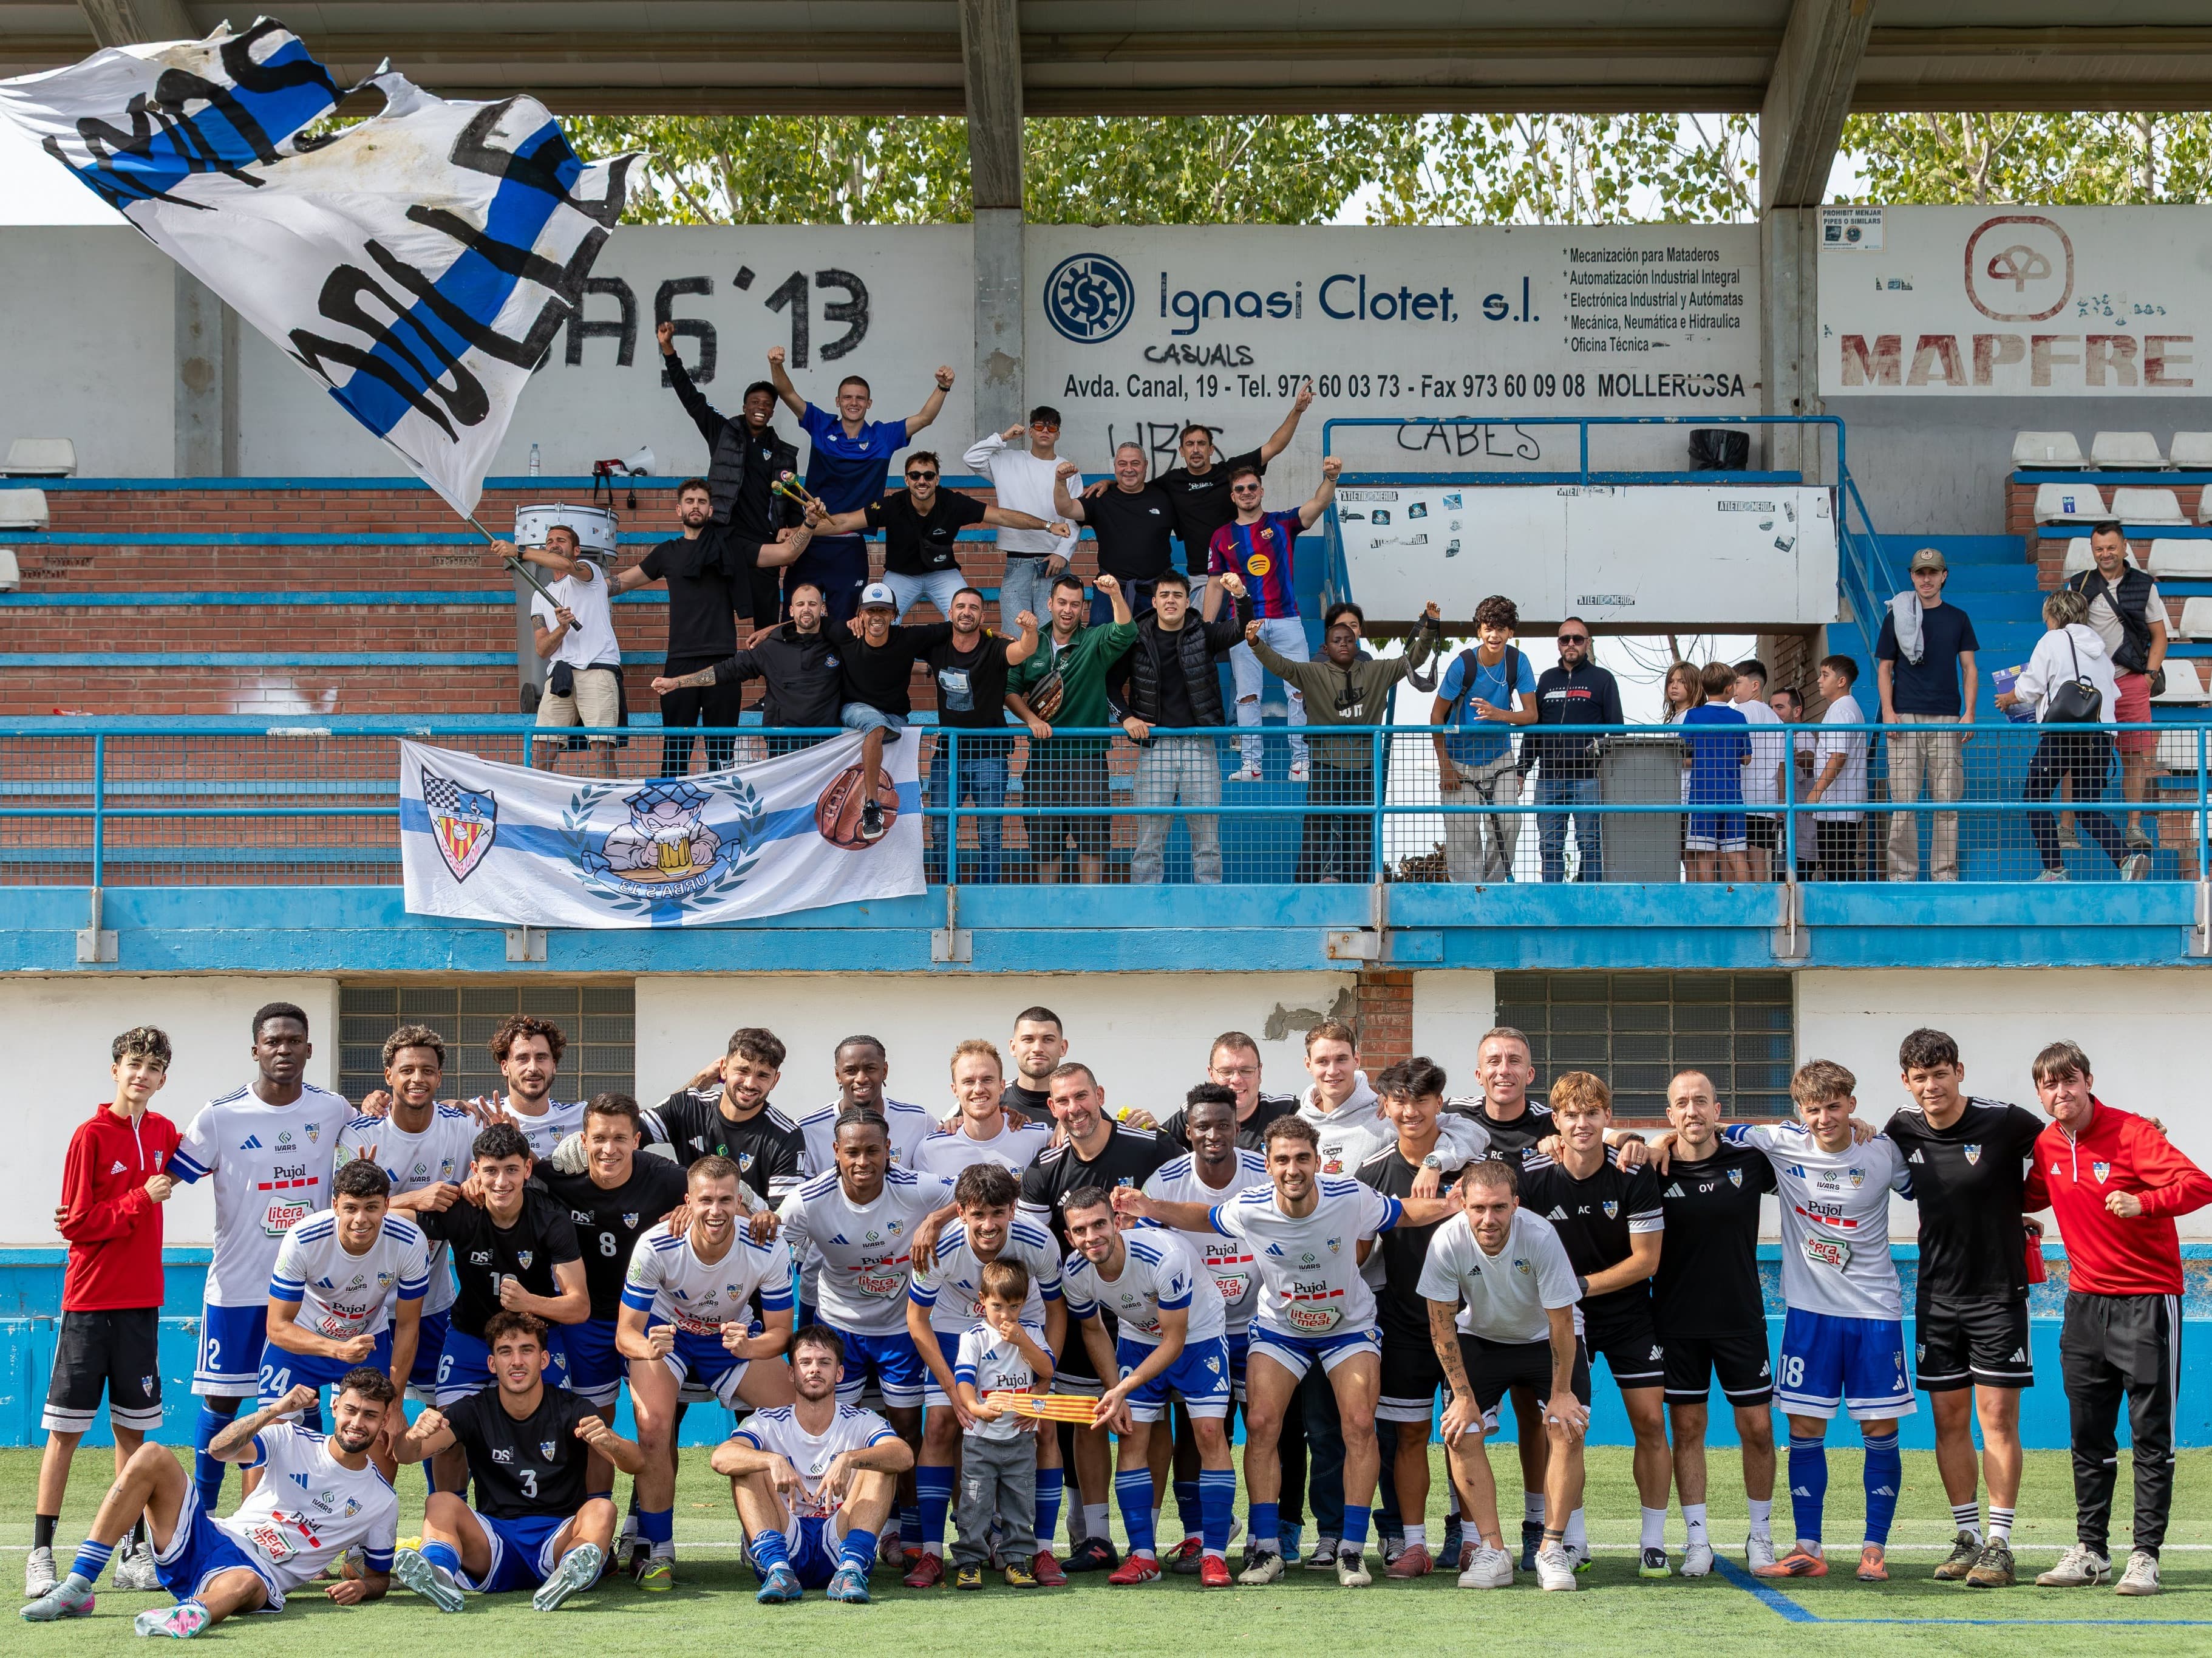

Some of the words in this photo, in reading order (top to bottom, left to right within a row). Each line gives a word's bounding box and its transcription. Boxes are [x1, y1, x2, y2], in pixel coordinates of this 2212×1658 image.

[1570, 247, 1638, 262] Mecanización
[1642, 250, 1663, 265] para
[1667, 247, 1719, 262] Mataderos
[1570, 269, 1649, 285] Automatización
[1652, 269, 1698, 284] Industrial
[1701, 268, 1740, 287] Integral
[1160, 271, 1302, 335] Ignasi
[1319, 274, 1458, 322] Clotet,
[1483, 276, 1540, 322] s.l.
[1571, 292, 1627, 307] Electrónica
[1630, 292, 1677, 307] Industrial
[1680, 295, 1686, 310] y
[1689, 291, 1743, 306] Autómatas
[1571, 315, 1621, 332] Mecánica,
[1624, 313, 1677, 329] Neumática
[1680, 318, 1686, 329] e
[1689, 313, 1740, 329] Hidraulica
[1571, 337, 1606, 352] Oficina
[1610, 336, 1649, 352] Técnica
[1144, 344, 1254, 367] CASUALS
[1841, 335, 2193, 386] MAPFRE
[1064, 374, 1119, 398] Avda.
[1126, 374, 1188, 401] Canal,
[1196, 374, 1217, 397] 19
[1237, 374, 1271, 397] Tel.
[1319, 374, 1341, 397] 60
[1349, 374, 1370, 397] 03
[1377, 374, 1400, 397] 73
[1421, 374, 1456, 398] Fax
[1463, 374, 1497, 397] 973
[1504, 374, 1526, 397] 60
[1533, 374, 1556, 397] 09
[1562, 374, 1585, 397] 08
[1598, 374, 1746, 397] MOLLERUSSA
[1354, 704, 1363, 717] IT
[1491, 1150, 1503, 1160] RC
[111, 1166, 128, 1175] adidas
[273, 1164, 306, 1179] Pujol
[1699, 1182, 1714, 1193] OV
[1817, 1181, 1840, 1190] IVARS
[268, 1207, 303, 1222] litera
[1578, 1206, 1590, 1214] AC
[1808, 1200, 1842, 1217] Pujol
[599, 1232, 616, 1257] 8
[1205, 1243, 1239, 1258] Pujol
[860, 1252, 894, 1265] Pujl
[346, 1283, 367, 1292] IVARS
[858, 1275, 893, 1286] litera
[867, 1280, 899, 1292] meat
[1293, 1280, 1327, 1294] Pujol
[1221, 1284, 1242, 1298] eat
[332, 1301, 367, 1314] Pujol
[1121, 1301, 1142, 1310] IVARS
[688, 1312, 722, 1323] Pujol
[1290, 1309, 1327, 1320] litera
[322, 1317, 358, 1333] litera
[1298, 1317, 1332, 1328] meat
[1781, 1354, 1805, 1388] 18
[258, 1364, 291, 1396] 24
[996, 1372, 1028, 1388] Pujol
[520, 1469, 537, 1498] 3
[312, 1498, 333, 1514] IVARS
[291, 1510, 324, 1533] Pujol
